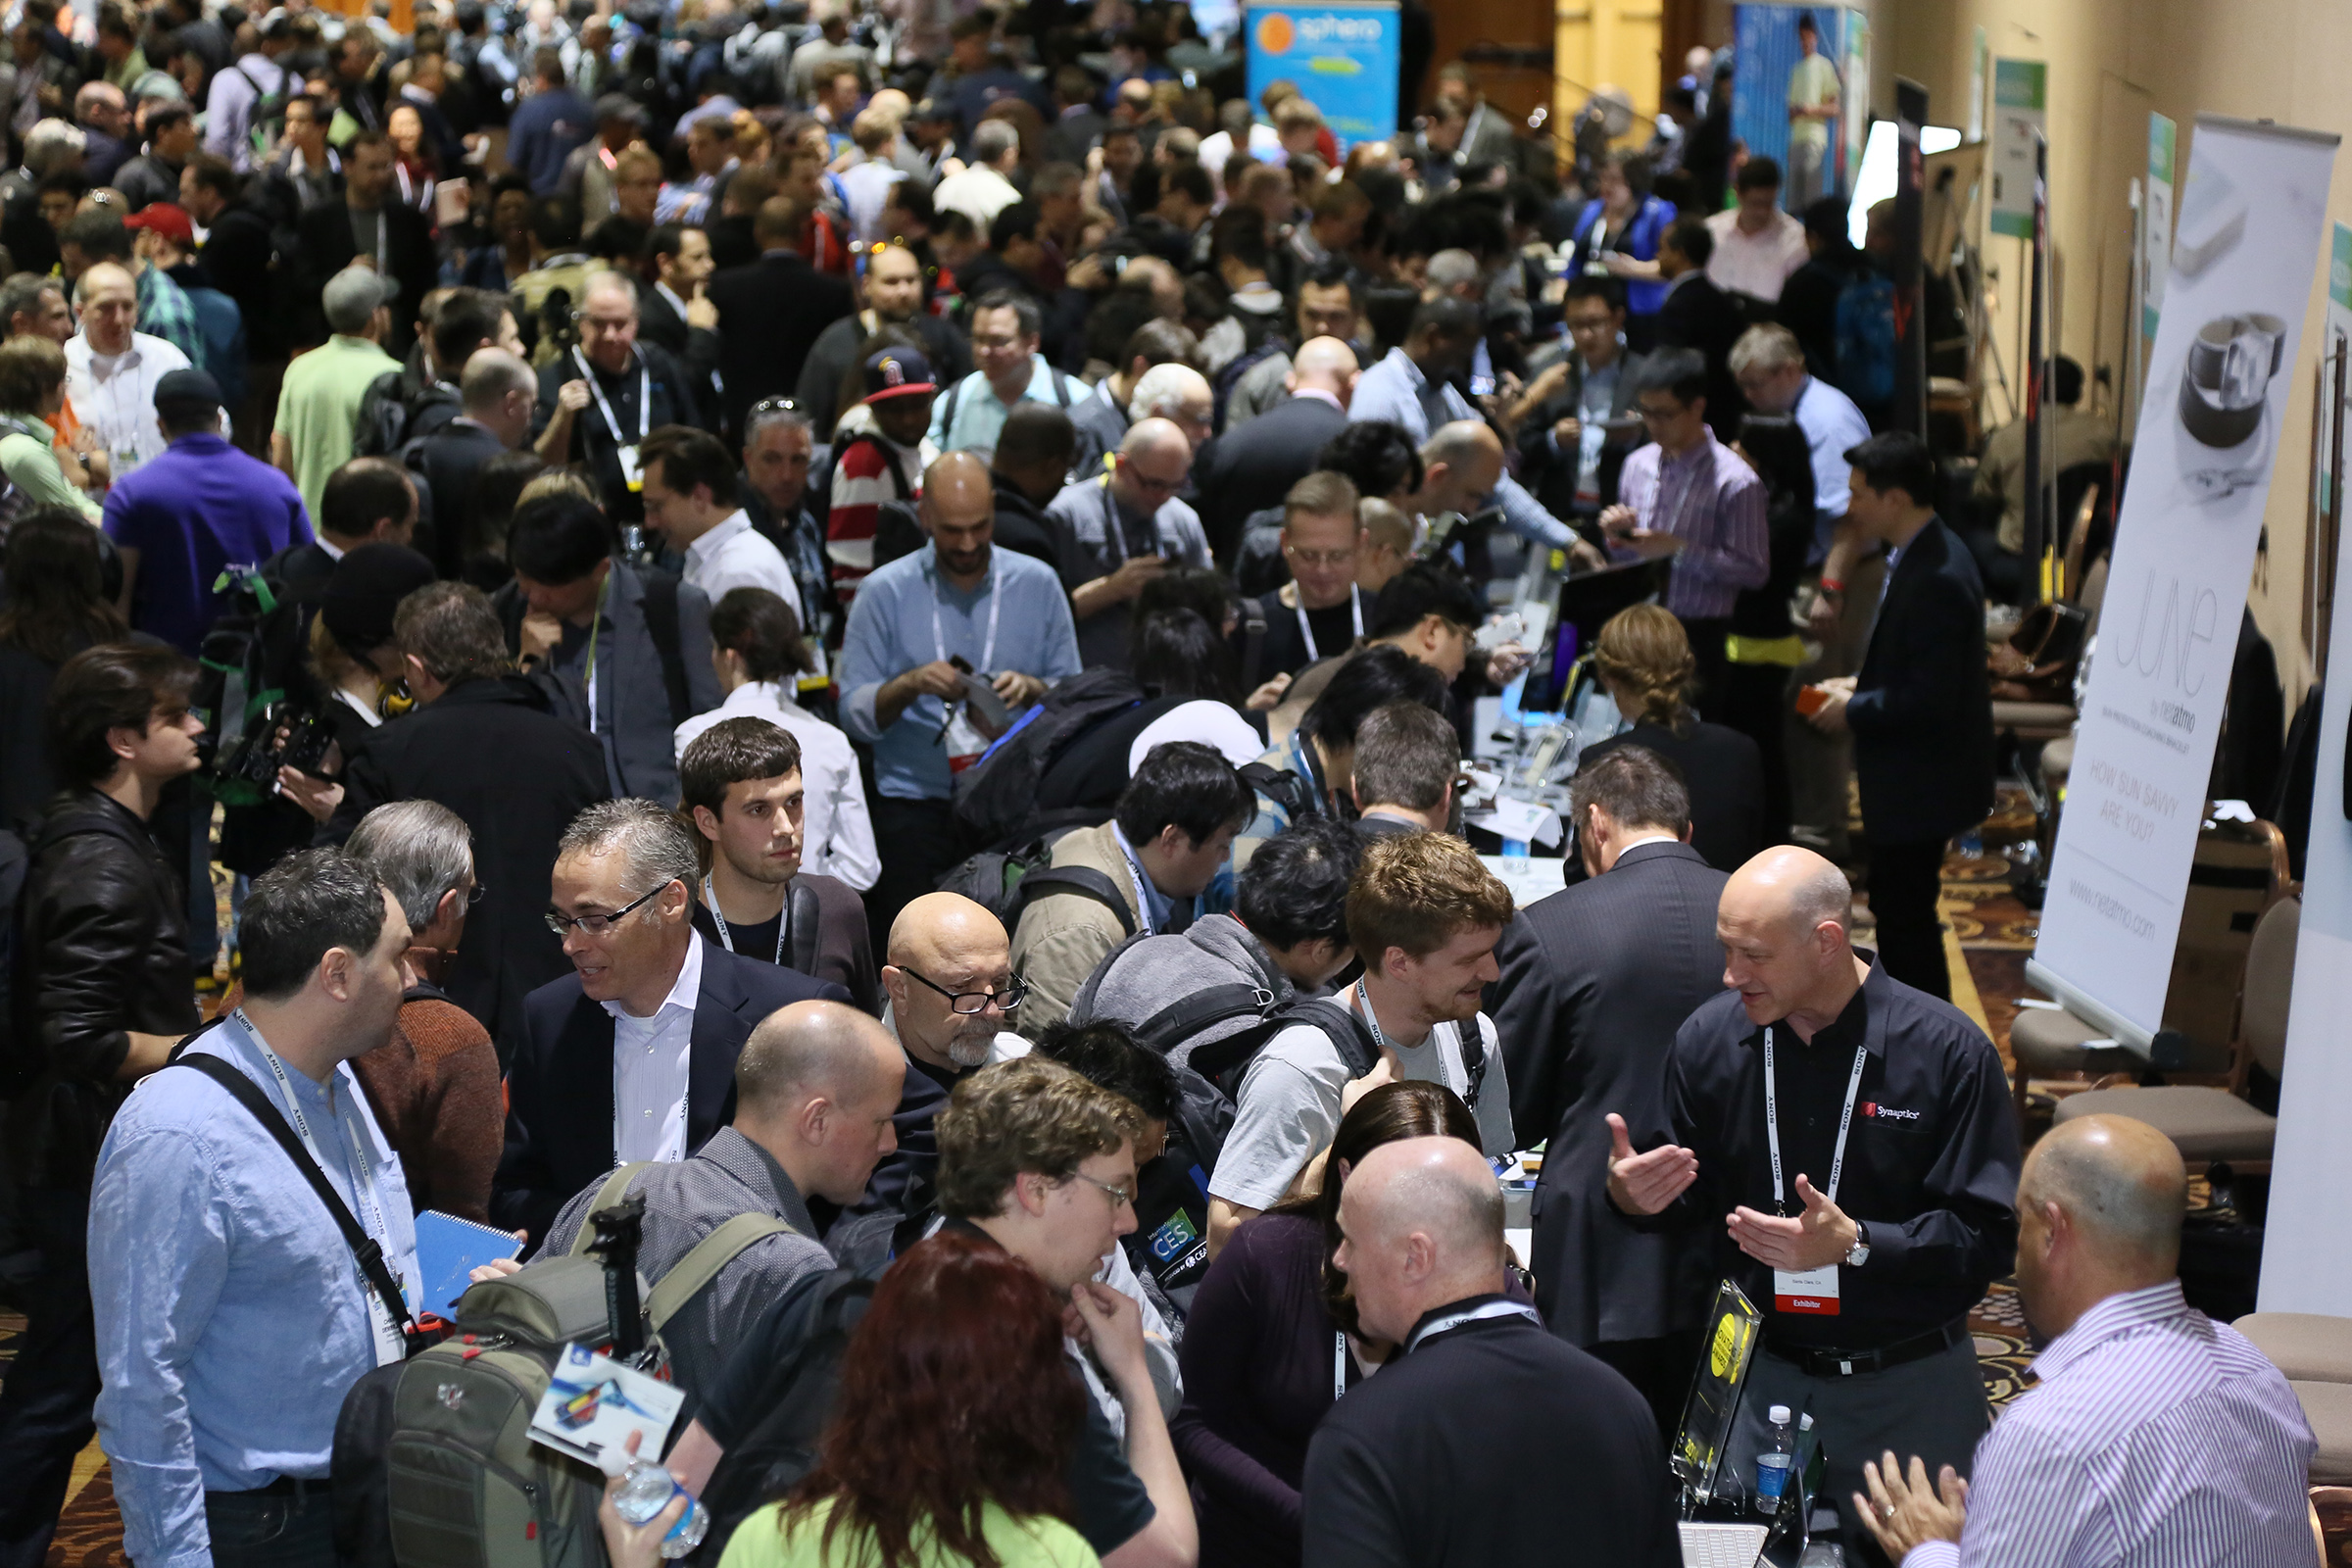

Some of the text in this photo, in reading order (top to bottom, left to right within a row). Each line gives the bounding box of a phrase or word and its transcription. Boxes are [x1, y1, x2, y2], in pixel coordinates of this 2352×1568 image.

[2159, 700, 2195, 735] netatmo
[2089, 758, 2179, 820] HOW SUN SAVVY
[2100, 799, 2156, 844] ARE YOU?
[714, 912, 728, 936] SONY
[2070, 878, 2156, 942] www.netatmo.com
[237, 1013, 254, 1033] SONY
[266, 1054, 285, 1081] SONY
[1854, 1047, 1867, 1076] SONY
[292, 1108, 309, 1137] SONY
[1841, 1102, 1852, 1131] SONY
[1877, 1105, 1918, 1120] Synaptics
[356, 1148, 368, 1177] SONY
[1772, 1152, 1782, 1181] SONY
[1832, 1157, 1841, 1186] SONY
[373, 1205, 385, 1235] SONY
[1153, 1224, 1189, 1257] CES
[1792, 1298, 1821, 1309] Exhibitor
